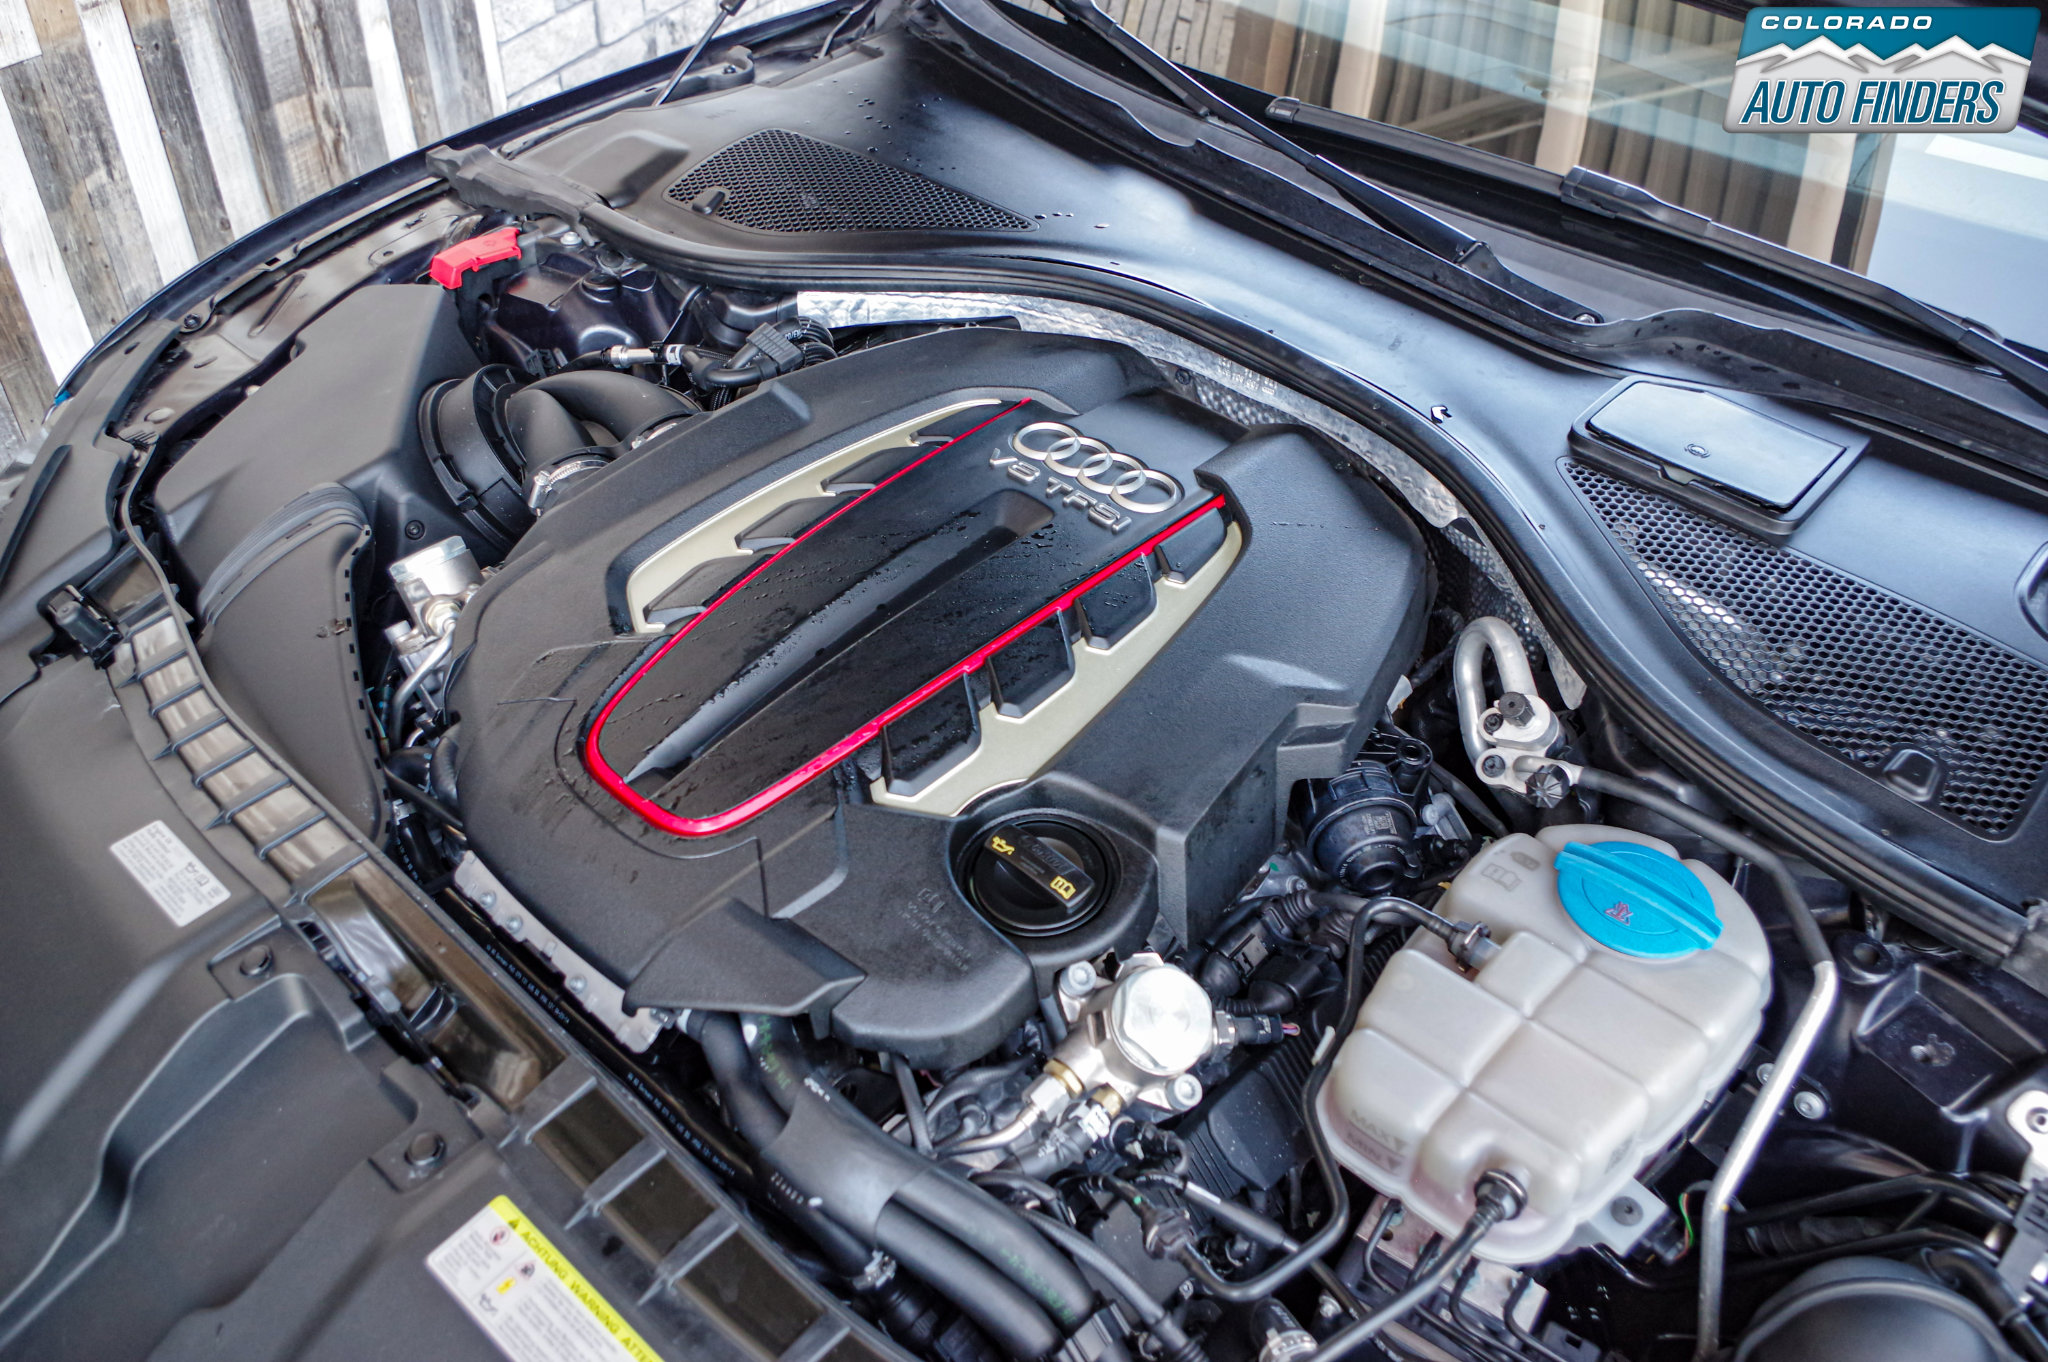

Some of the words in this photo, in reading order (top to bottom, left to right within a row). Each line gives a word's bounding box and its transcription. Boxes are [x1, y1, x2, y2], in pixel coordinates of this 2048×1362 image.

[989, 447, 1041, 483] V8
[1045, 476, 1133, 533] TFSI
[520, 1230, 569, 1281] ACHTUNG
[570, 1280, 621, 1335] WARNING
